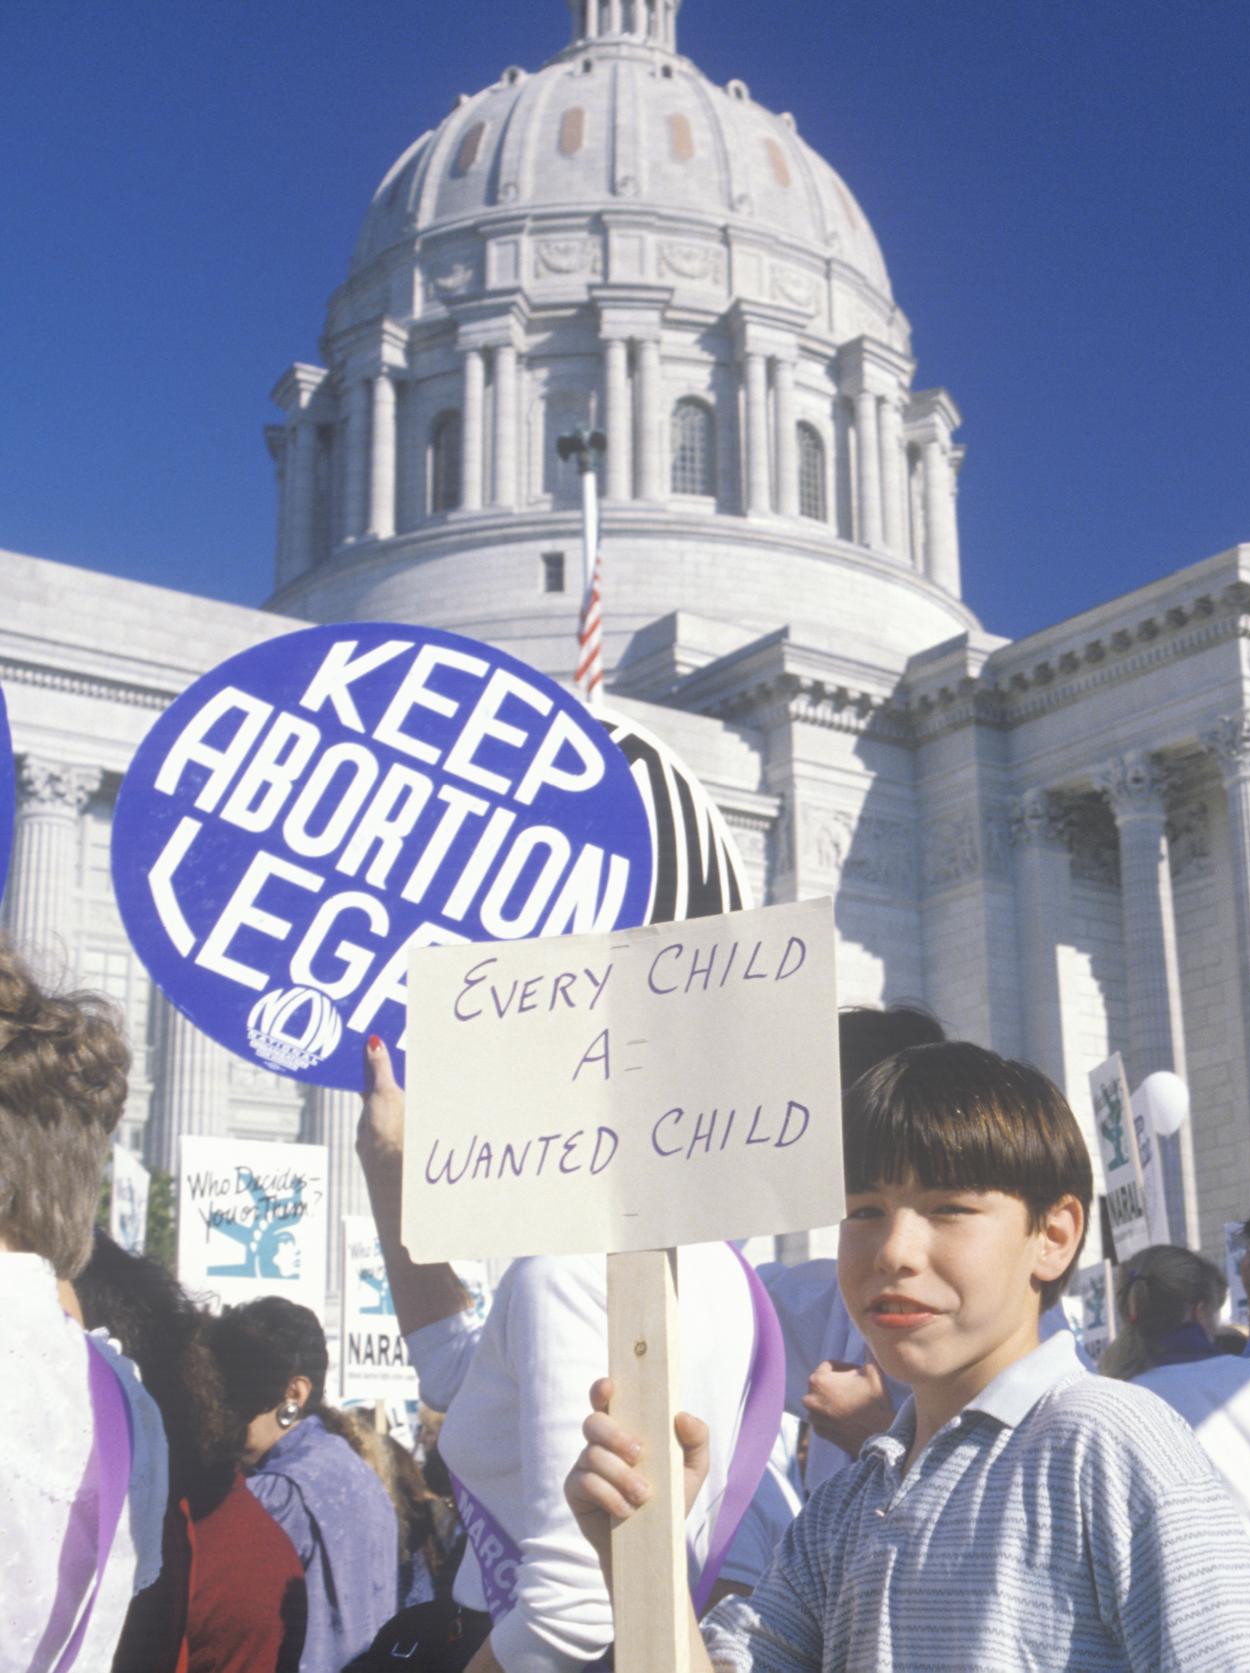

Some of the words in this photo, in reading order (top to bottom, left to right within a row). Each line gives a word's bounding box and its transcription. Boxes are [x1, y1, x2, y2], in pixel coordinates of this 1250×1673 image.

[299, 640, 605, 804] KEEP
[154, 686, 630, 939] ABORTION
[148, 816, 472, 1051] LEGA
[454, 957, 614, 1021] EVERY
[648, 936, 807, 994] CHILD
[425, 1126, 619, 1184] WANTED
[652, 1100, 810, 1159] CHILD
[187, 1171, 231, 1200] Who
[199, 1200, 238, 1243] You
[348, 1332, 410, 1366] NARA
[458, 1489, 521, 1590] MARC
